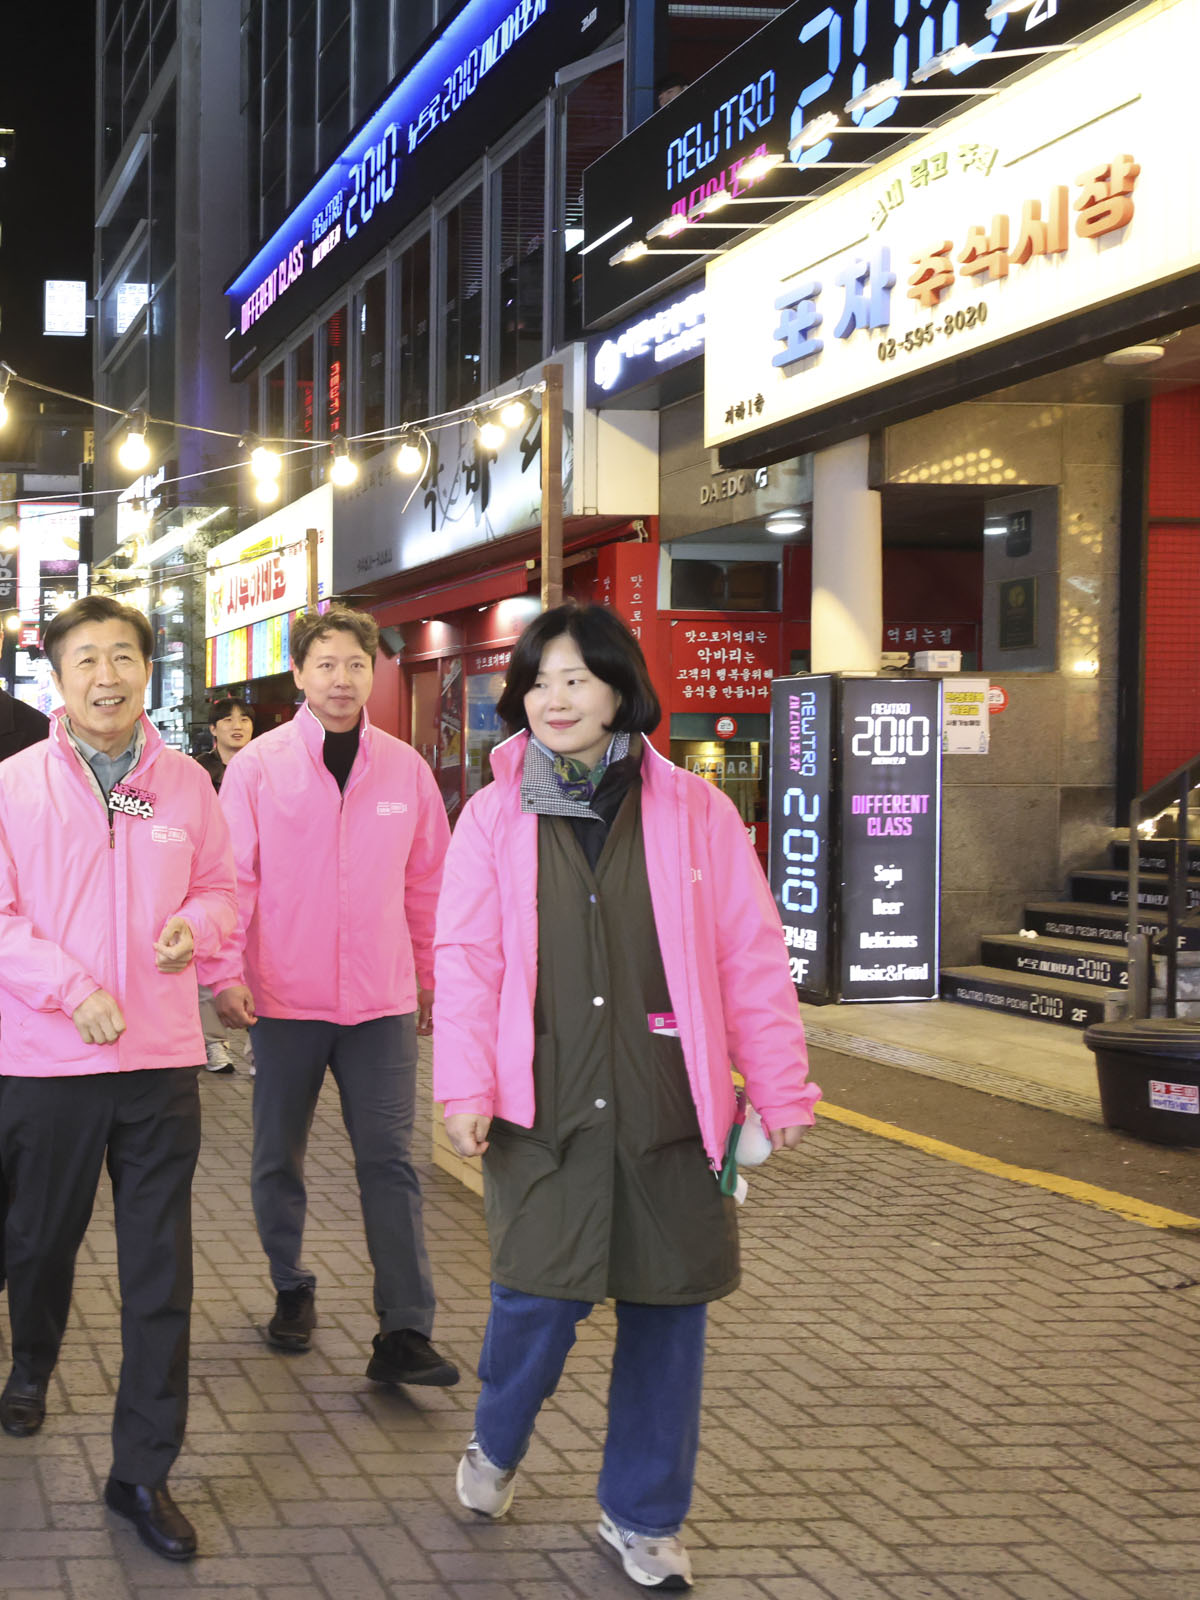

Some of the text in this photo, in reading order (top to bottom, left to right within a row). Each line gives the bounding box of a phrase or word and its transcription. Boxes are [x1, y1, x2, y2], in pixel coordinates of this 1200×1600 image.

[441, 48, 479, 123] 2010
[666, 69, 776, 191] NEWTRO
[345, 121, 398, 239] 2010
[771, 244, 897, 371] 포차
[905, 152, 1142, 309] 주식시장
[240, 267, 279, 336] DIFFERENT
[278, 239, 304, 296] CLASS
[877, 301, 988, 363] 02-595-8020
[684, 630, 768, 643] 맛으로기억되는
[696, 647, 756, 665] 악바리는
[675, 667, 711, 681] 고객의
[681, 685, 769, 699] 음식을 만듭니다
[800, 691, 817, 777] NEWTRO
[851, 715, 930, 756] 2010
[691, 760, 759, 776] AKBARI
[108, 791, 154, 819] 전성수
[851, 793, 930, 815] DIFFERENT
[866, 816, 913, 837] CLASS
[781, 786, 820, 914] 2010
[1076, 958, 1112, 983] 2010
[1029, 993, 1064, 1019] 2010
[1071, 1007, 1088, 1022] 2F
